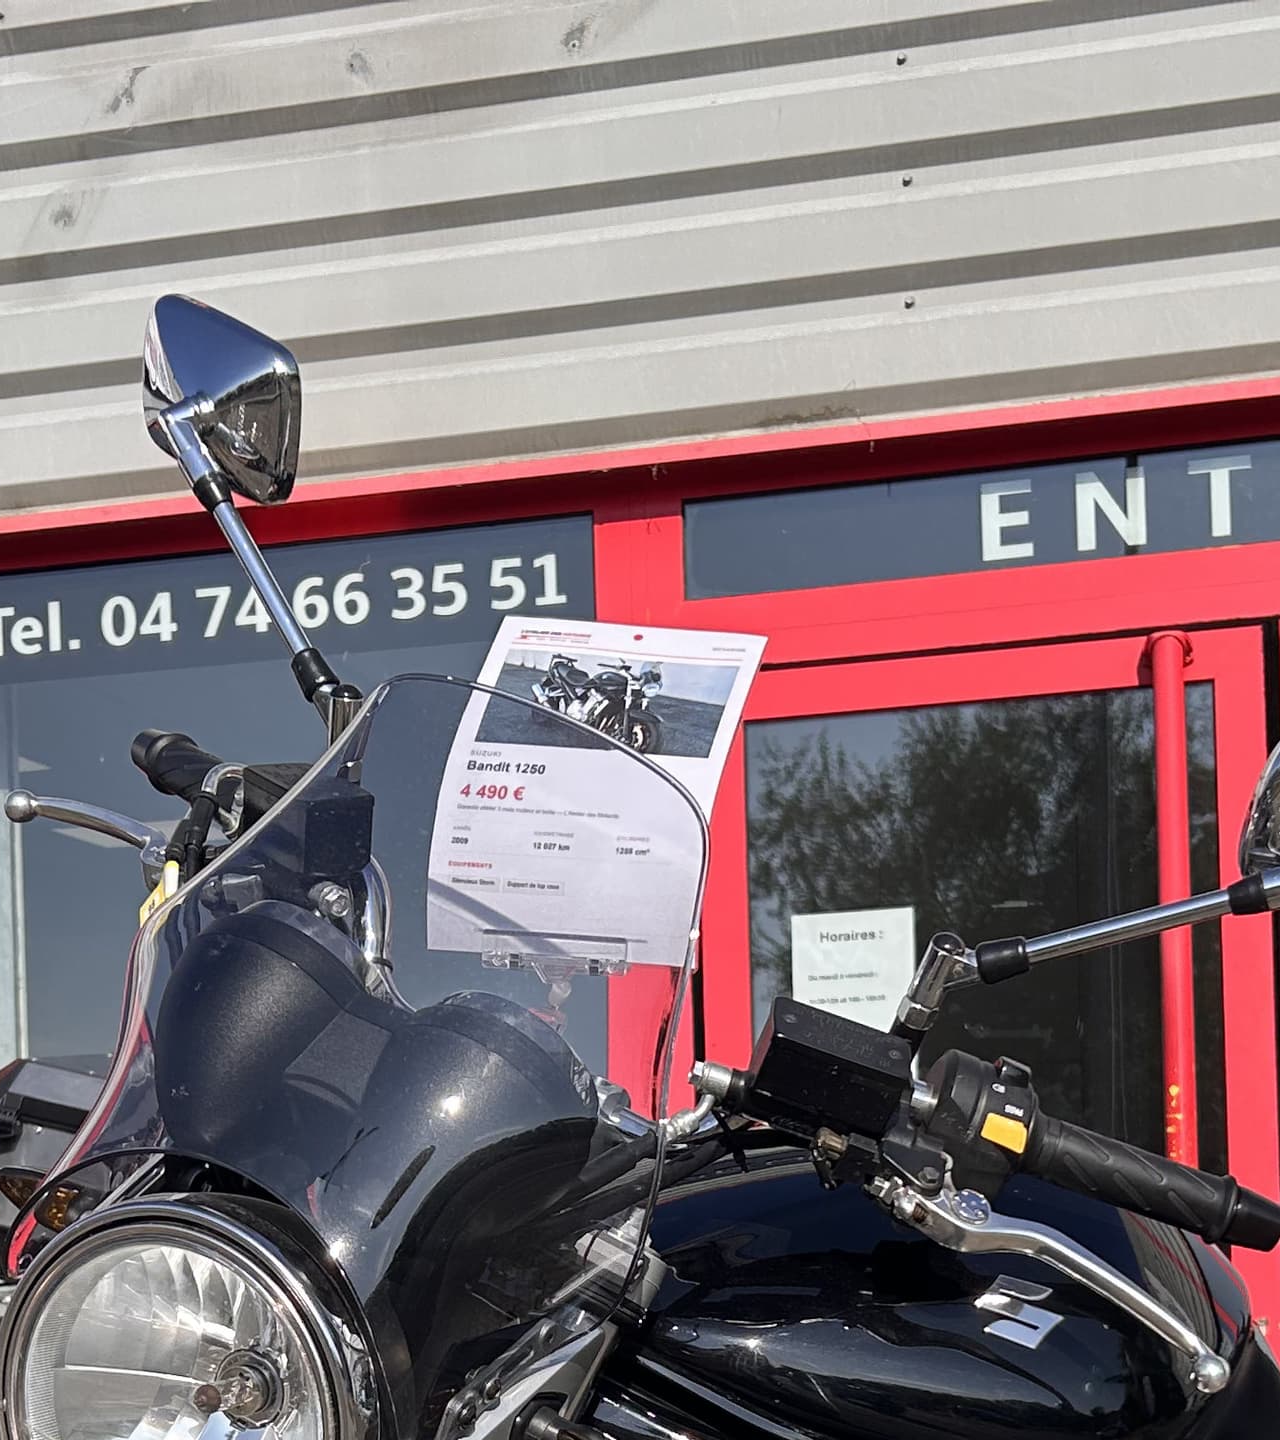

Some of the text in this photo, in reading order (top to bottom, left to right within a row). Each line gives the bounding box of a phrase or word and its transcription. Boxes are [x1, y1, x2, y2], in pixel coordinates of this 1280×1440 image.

[100, 591, 177, 647] 04
[194, 584, 271, 638] 74
[293, 571, 372, 629] 66
[390, 562, 468, 620] 35
[488, 553, 568, 610] 51
[467, 760, 546, 775] Bandit 1250
[460, 784, 526, 801] 4 490 €
[819, 929, 876, 944] Horaires
